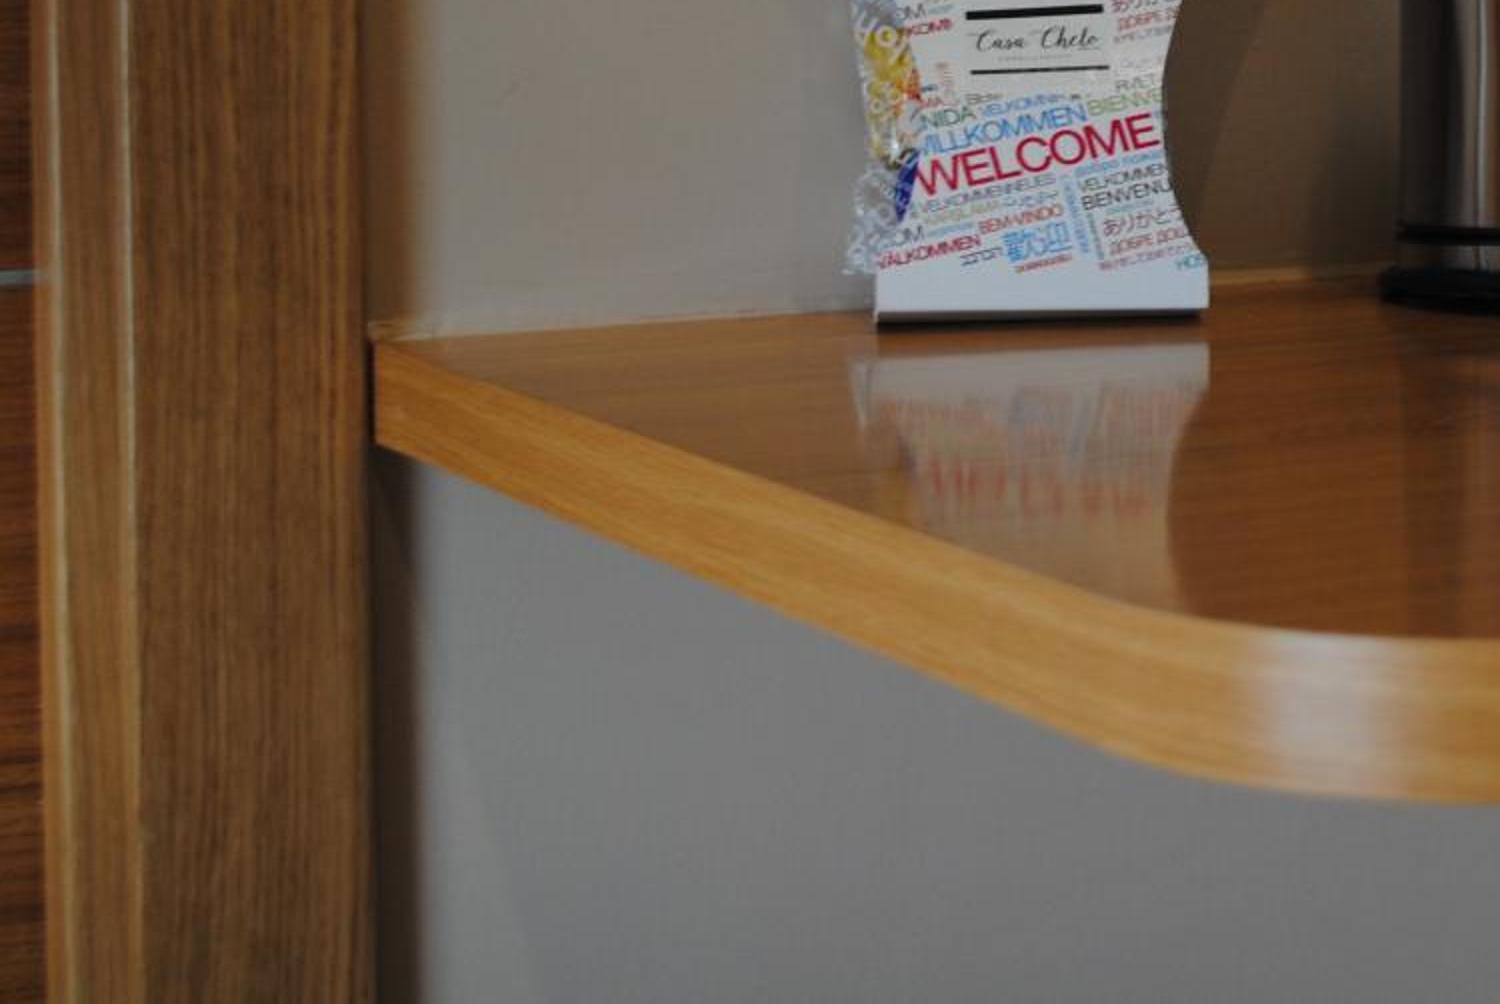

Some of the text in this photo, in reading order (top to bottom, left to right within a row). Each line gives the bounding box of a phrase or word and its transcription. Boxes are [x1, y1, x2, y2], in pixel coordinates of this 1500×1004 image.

[975, 29, 1025, 52] Casa
[1040, 24, 1100, 52] Chelo
[917, 112, 1160, 197] WELCOME
